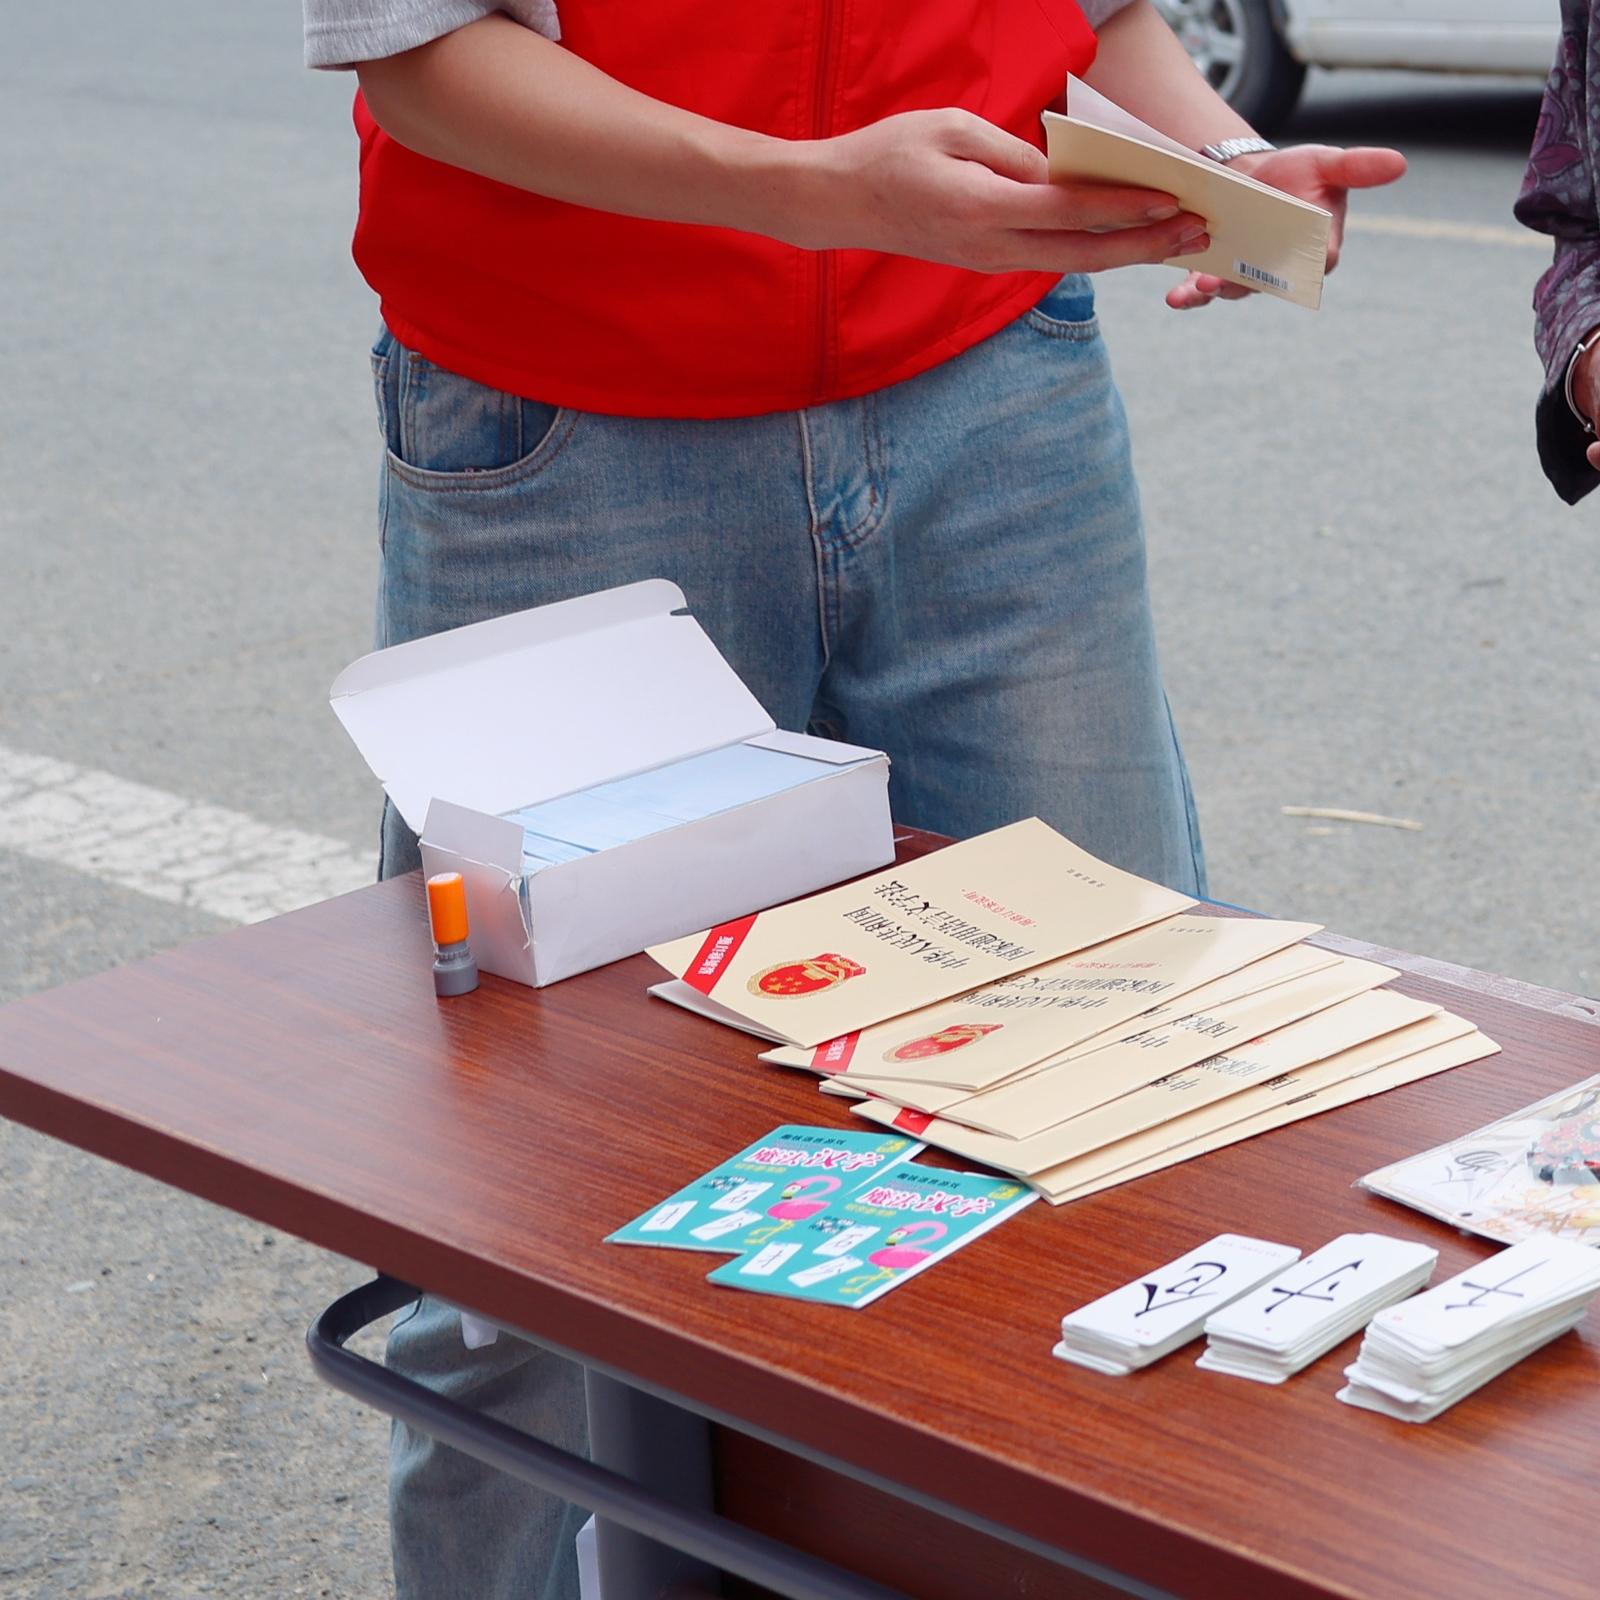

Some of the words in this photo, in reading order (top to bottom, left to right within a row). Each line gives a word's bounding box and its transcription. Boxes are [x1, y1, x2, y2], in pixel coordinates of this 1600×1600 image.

[842, 905, 971, 969] 中华人民共和国
[873, 880, 1036, 962] 国家通用语言文字法
[1133, 1260, 1228, 1319] 仓
[1264, 1257, 1366, 1315] 寸
[1443, 1257, 1552, 1311] 千
